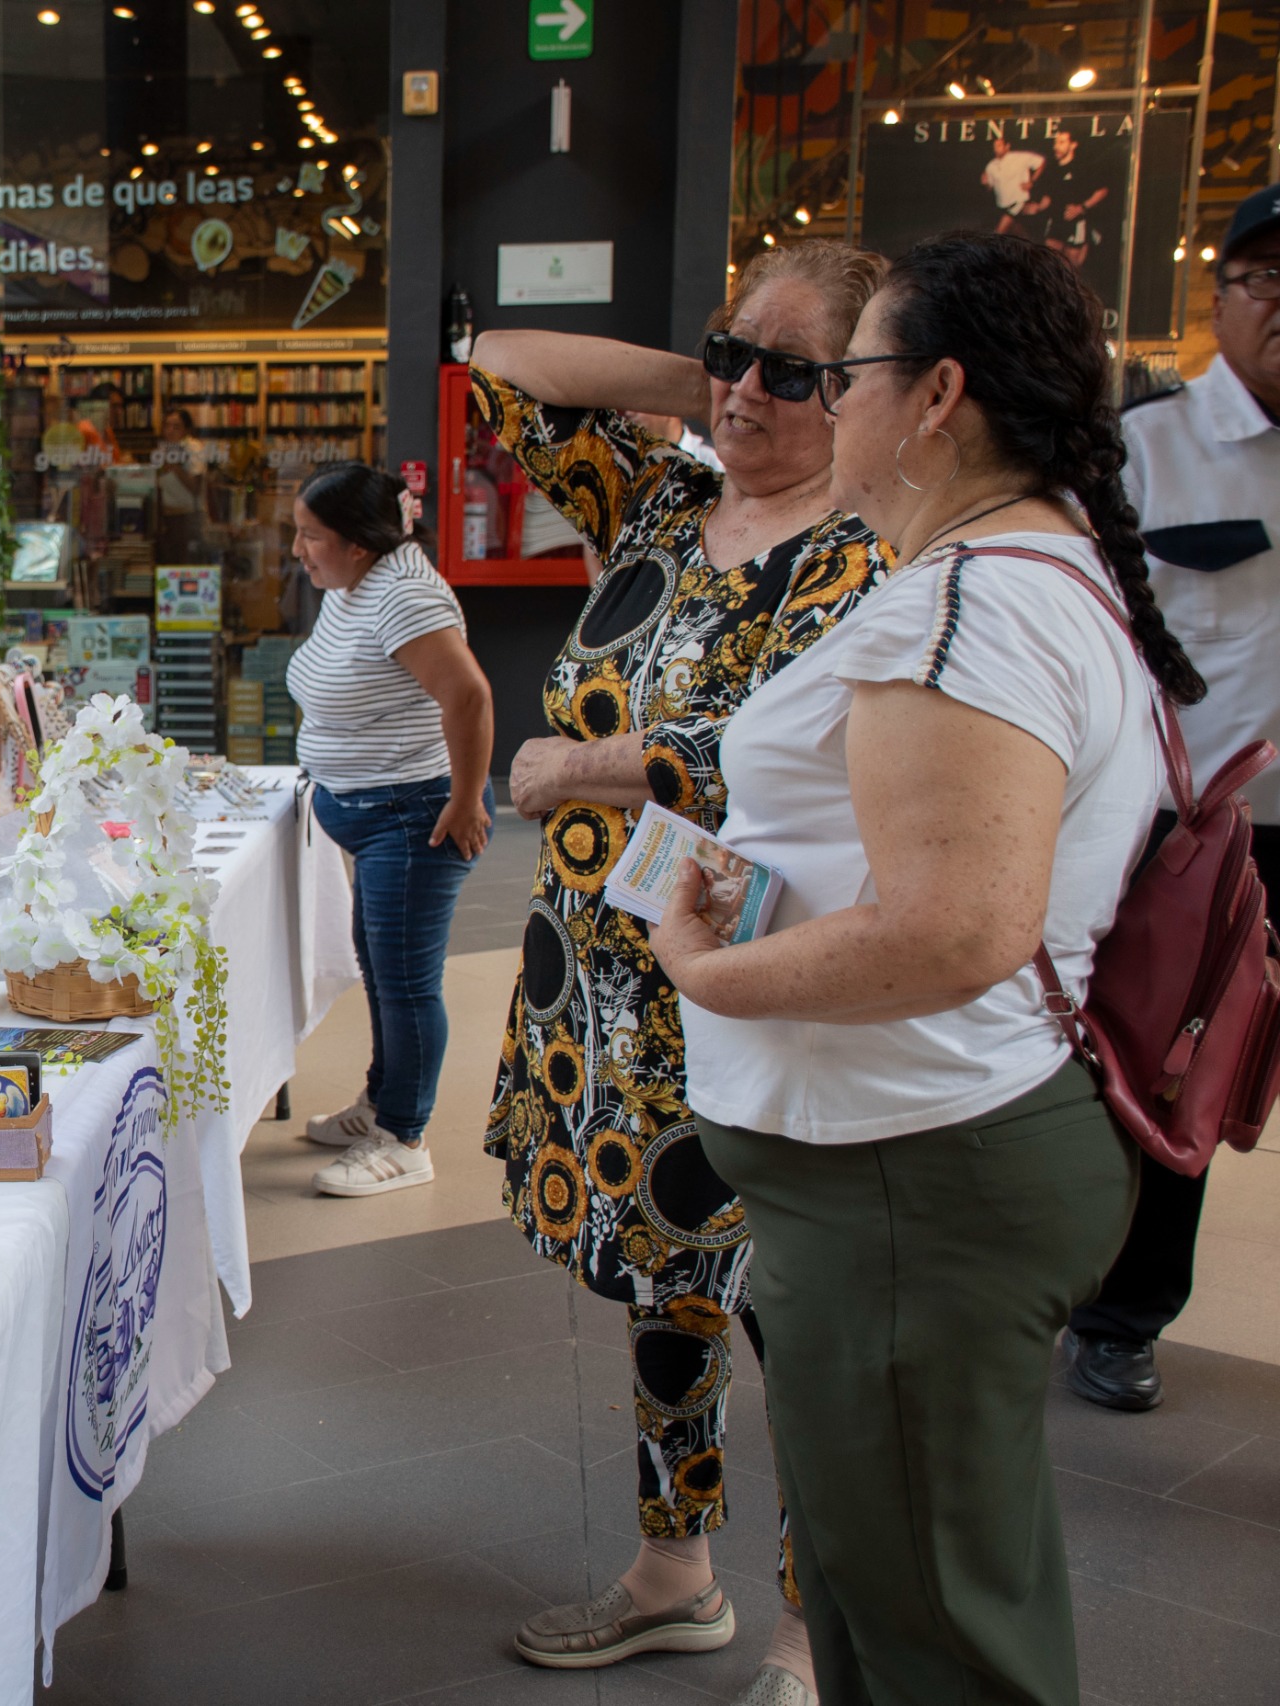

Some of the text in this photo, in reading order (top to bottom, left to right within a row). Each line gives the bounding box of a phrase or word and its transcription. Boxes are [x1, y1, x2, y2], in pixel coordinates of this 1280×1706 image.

[913, 113, 1135, 143] SIENTE LA
[62, 174, 105, 208] de
[113, 178, 178, 214] que
[186, 170, 254, 205] leas
[34, 445, 113, 471] gandhi
[150, 444, 230, 469] gandhi
[623, 851, 645, 883] CONOCE
[638, 855, 661, 888] RECUPERA
[661, 823, 673, 845] SALUD
[649, 859, 665, 882] FORMA
[661, 830, 677, 861] NATURAL
